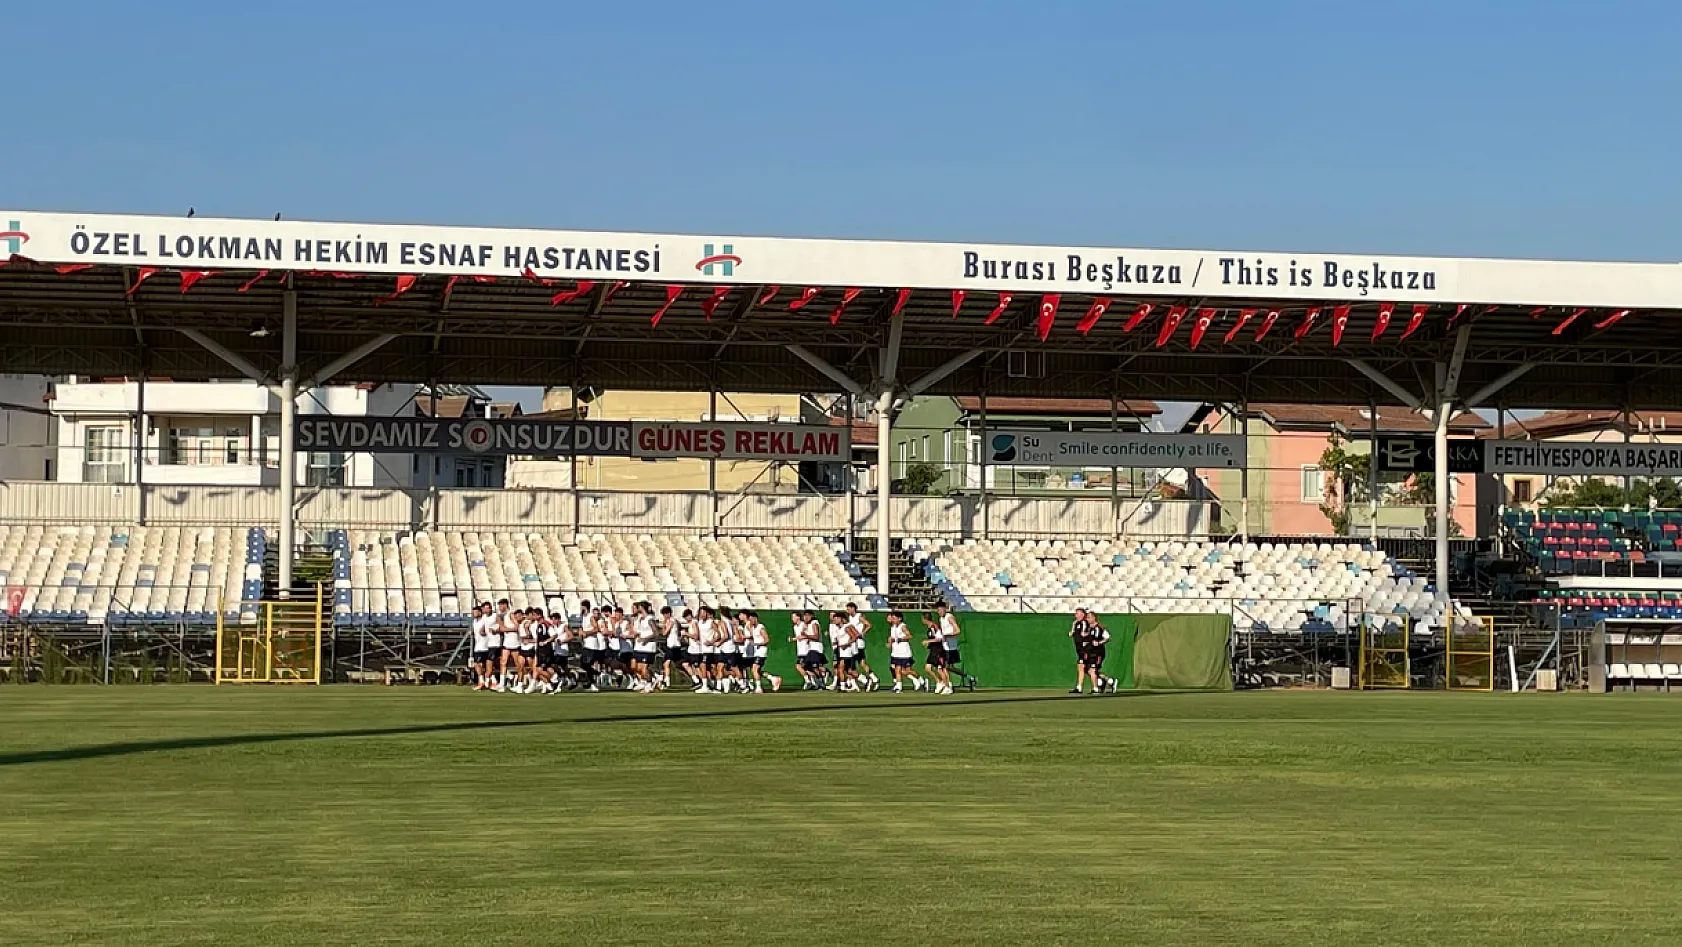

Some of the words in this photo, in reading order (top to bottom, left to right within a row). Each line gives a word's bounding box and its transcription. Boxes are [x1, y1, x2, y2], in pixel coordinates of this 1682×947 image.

[71, 225, 148, 256] ÖZEL
[158, 233, 283, 261] LOKMAN
[294, 233, 388, 265] HEKİM
[400, 242, 494, 268] ESNAF
[503, 244, 661, 273] HASTANESİ
[963, 250, 1056, 281] Burası
[1066, 254, 1182, 291] Beşkaza
[1218, 257, 1279, 286] This
[1289, 259, 1313, 288] is
[1322, 260, 1437, 296] Beşkaza
[299, 420, 439, 448] SEVDAMIZ
[637, 424, 726, 458] GÜNEŞ
[734, 430, 839, 456] REKLAM
[1022, 437, 1040, 448] Su
[1022, 450, 1054, 462] Dent
[1058, 442, 1099, 456] Smile
[1102, 441, 1186, 459] confidently
[1188, 445, 1204, 456] at
[1206, 443, 1234, 457] life.
[1494, 441, 1622, 469] FETHİYESPOR'A
